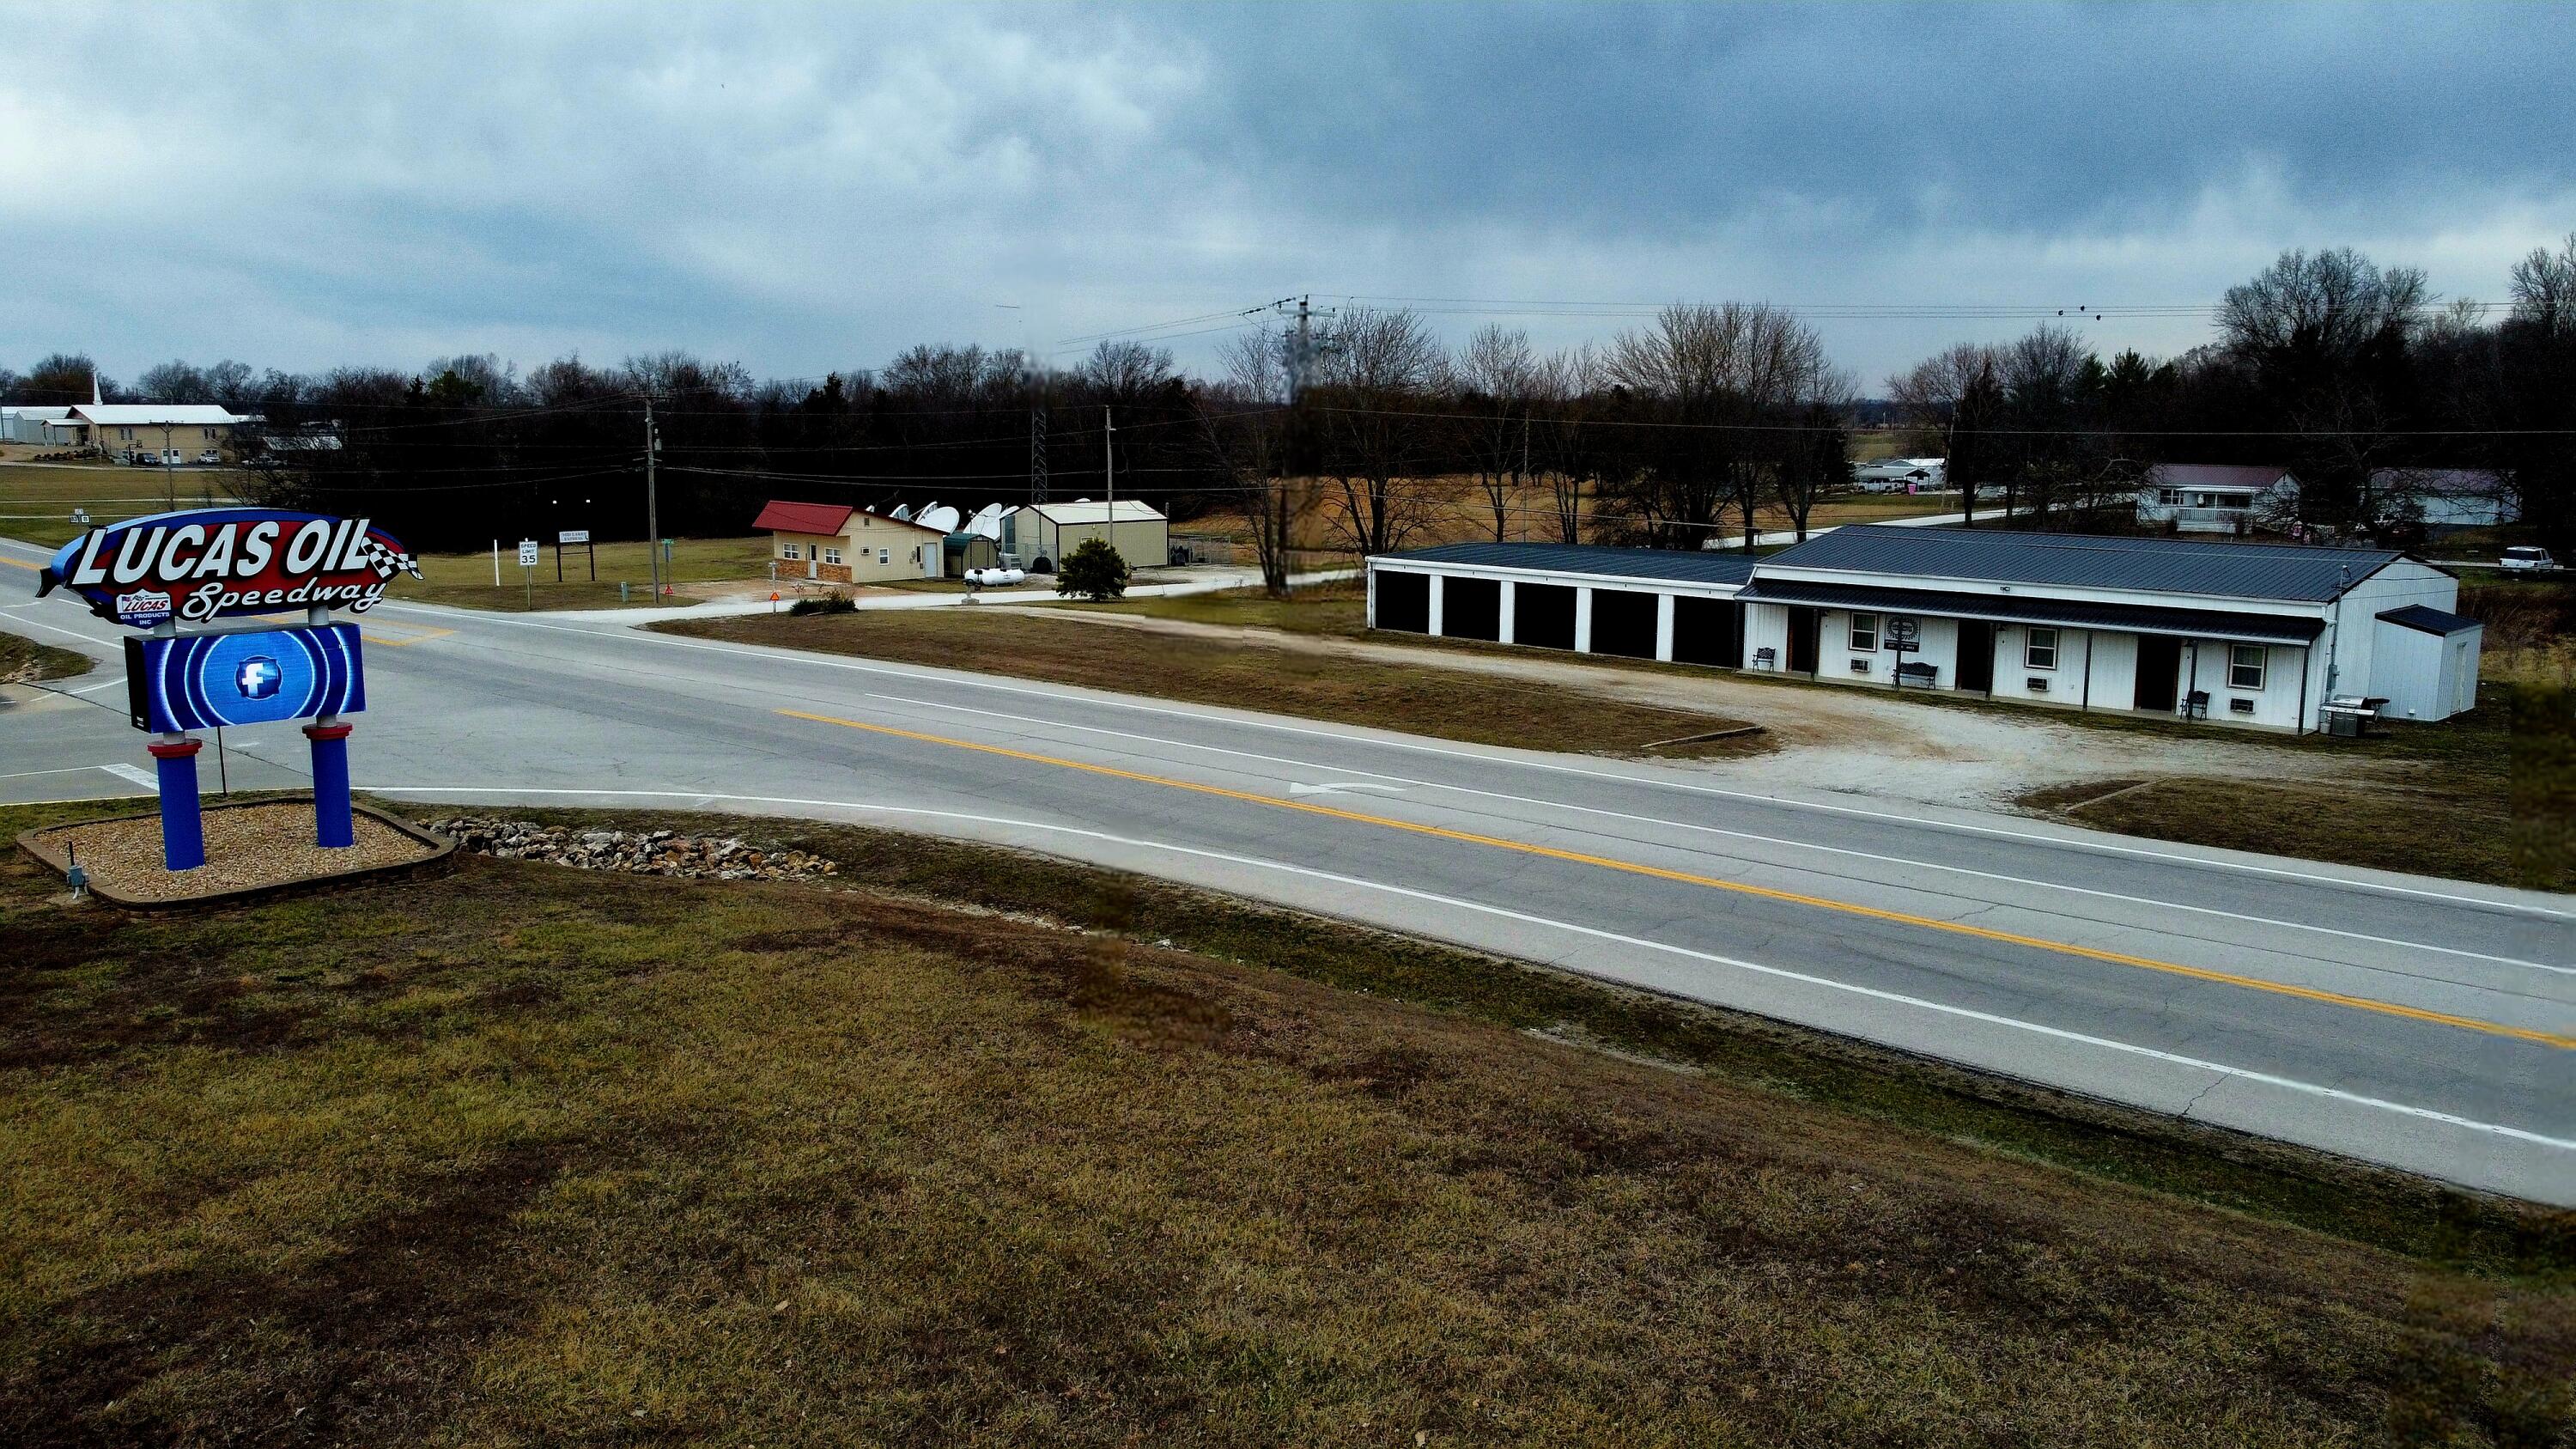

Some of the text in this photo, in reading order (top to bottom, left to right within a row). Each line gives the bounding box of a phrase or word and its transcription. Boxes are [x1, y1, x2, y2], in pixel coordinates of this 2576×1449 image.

[71, 519, 370, 585] LUCAS OIL
[521, 555, 536, 563] 35
[123, 600, 168, 612] LUCAS
[182, 576, 386, 620] Speedway
